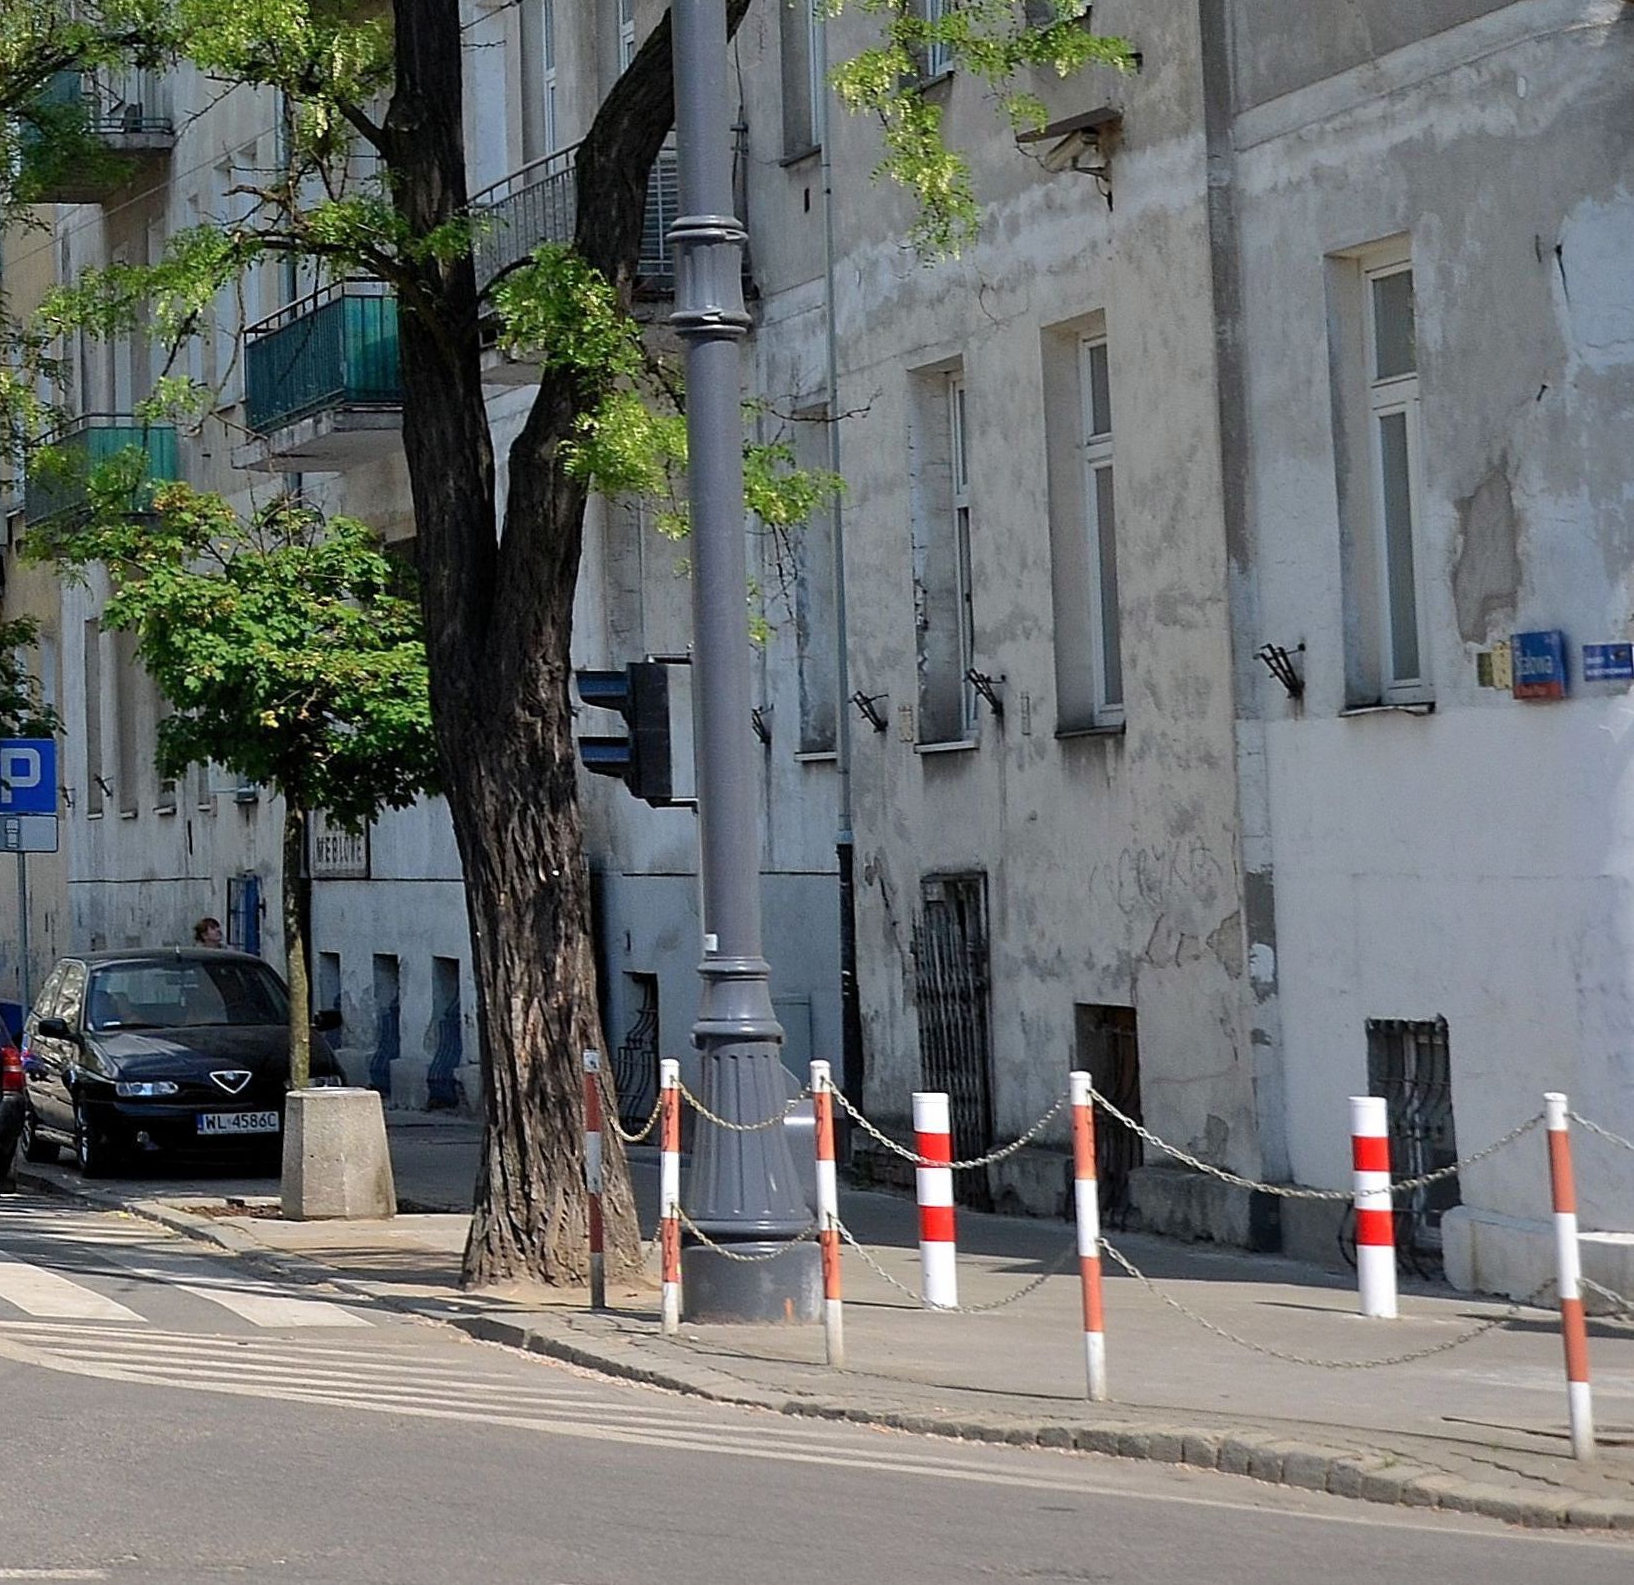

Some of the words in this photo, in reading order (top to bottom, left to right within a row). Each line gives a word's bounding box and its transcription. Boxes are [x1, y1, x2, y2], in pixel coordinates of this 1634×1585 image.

[0, 748, 40, 803] P
[205, 1115, 226, 1129] WL
[232, 1113, 277, 1128] 4586C
